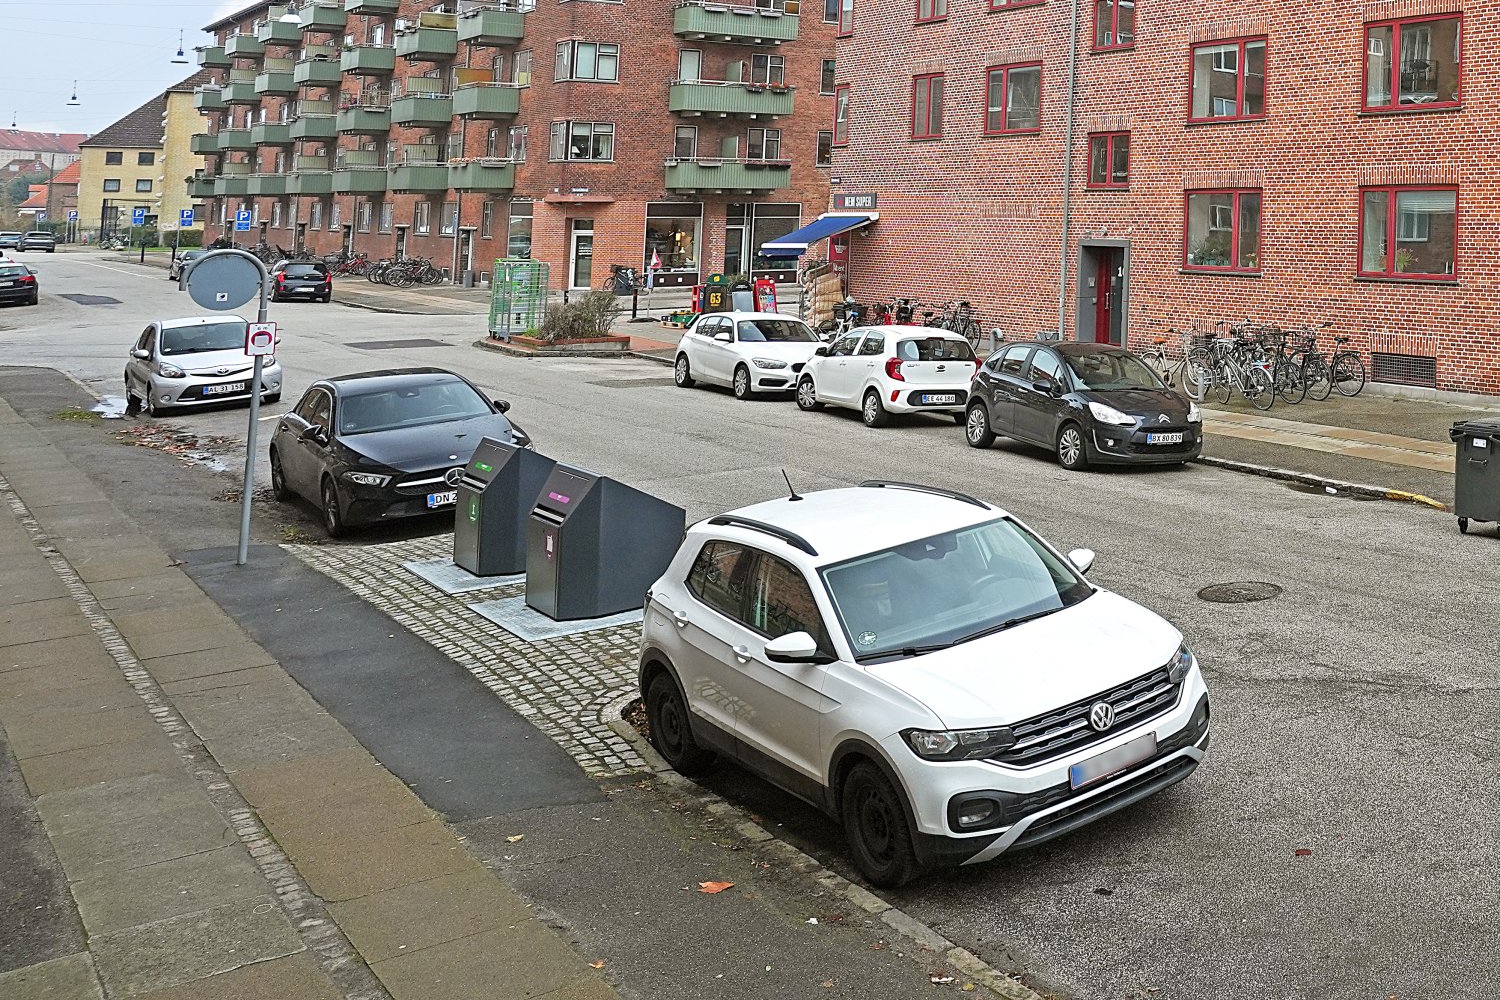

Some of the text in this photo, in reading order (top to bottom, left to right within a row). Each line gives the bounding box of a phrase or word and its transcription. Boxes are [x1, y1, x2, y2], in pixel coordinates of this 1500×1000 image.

[856, 196, 872, 206] SUPER
[240, 212, 249, 220] P
[710, 293, 721, 304] 63
[231, 383, 244, 391] 158
[1152, 434, 1182, 442] BX 80 839
[435, 494, 450, 504] DN
[1092, 703, 1114, 731] VW
